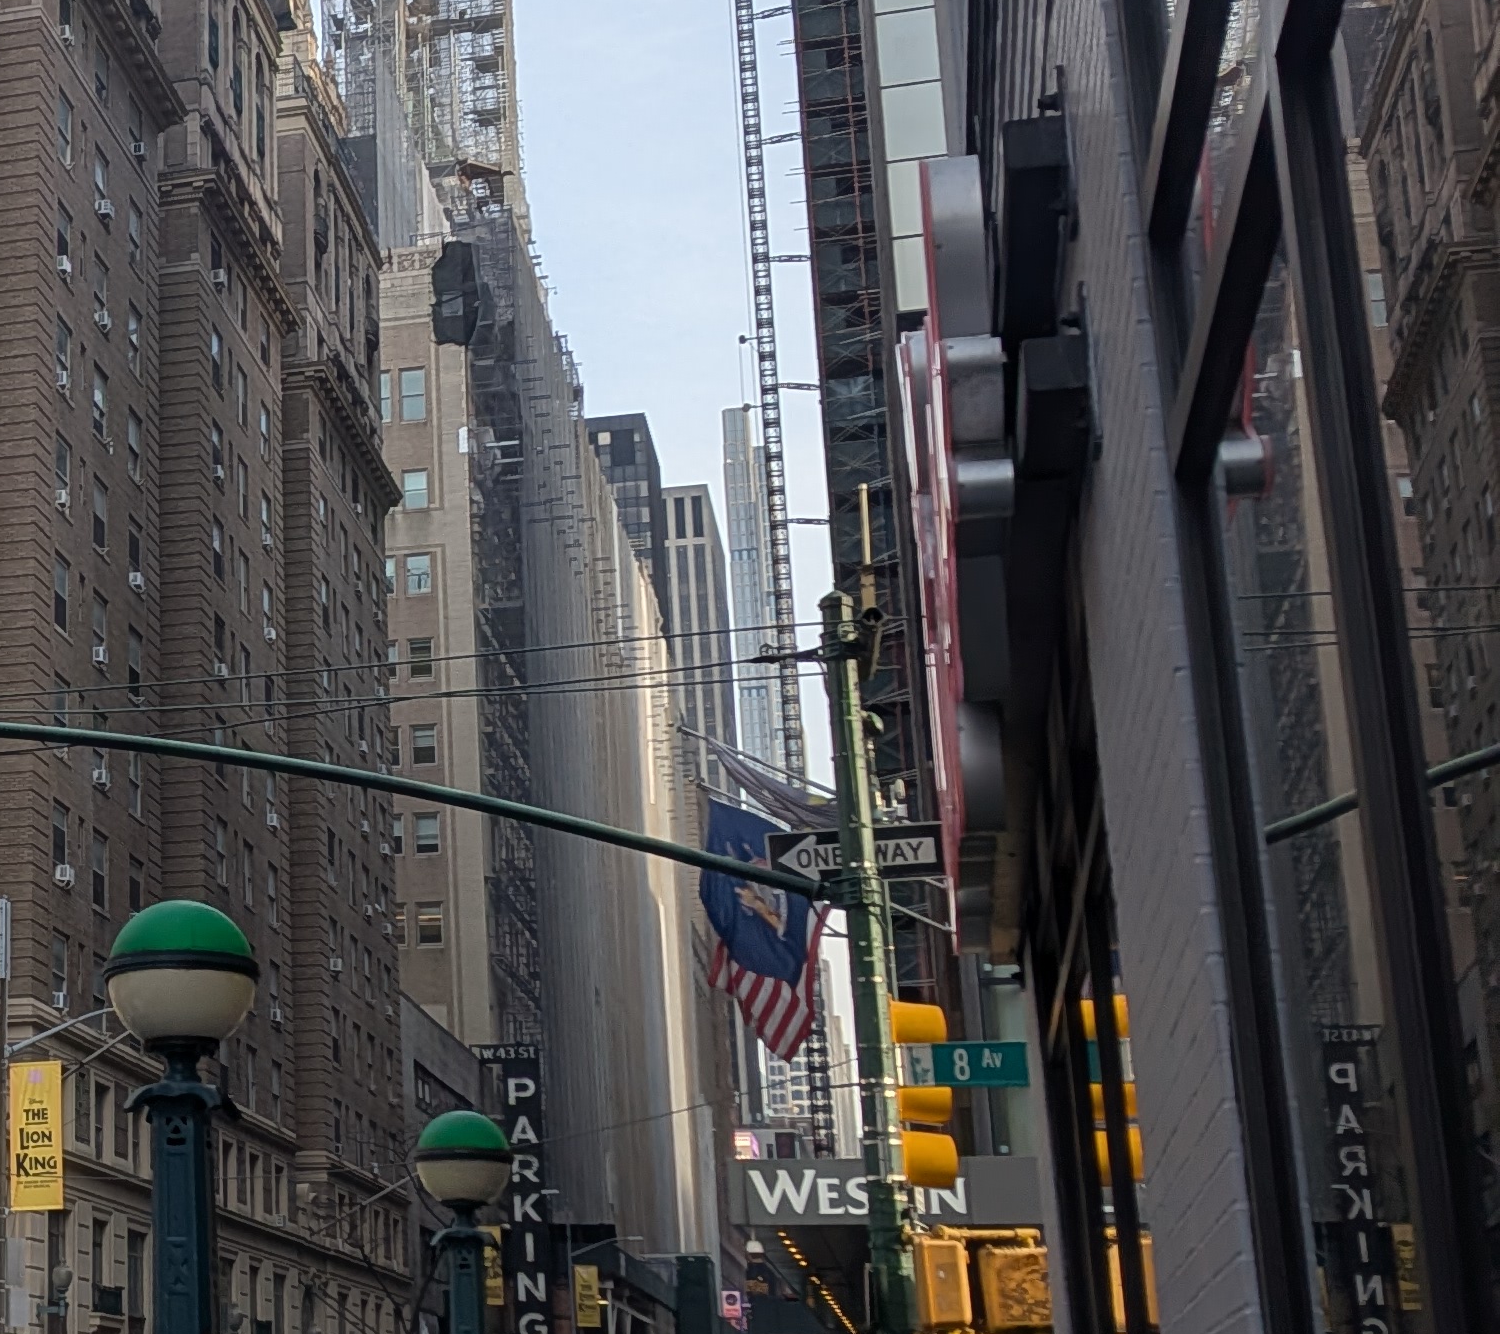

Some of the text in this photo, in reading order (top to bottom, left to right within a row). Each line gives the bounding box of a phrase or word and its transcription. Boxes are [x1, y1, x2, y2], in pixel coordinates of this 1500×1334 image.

[481, 1047, 494, 1059] W
[518, 1047, 536, 1059] ST
[952, 1047, 971, 1081] 8
[23, 1107, 49, 1122] THE
[18, 1127, 53, 1150] LION
[15, 1152, 58, 1178] KING
[747, 1169, 968, 1215] WESIN
